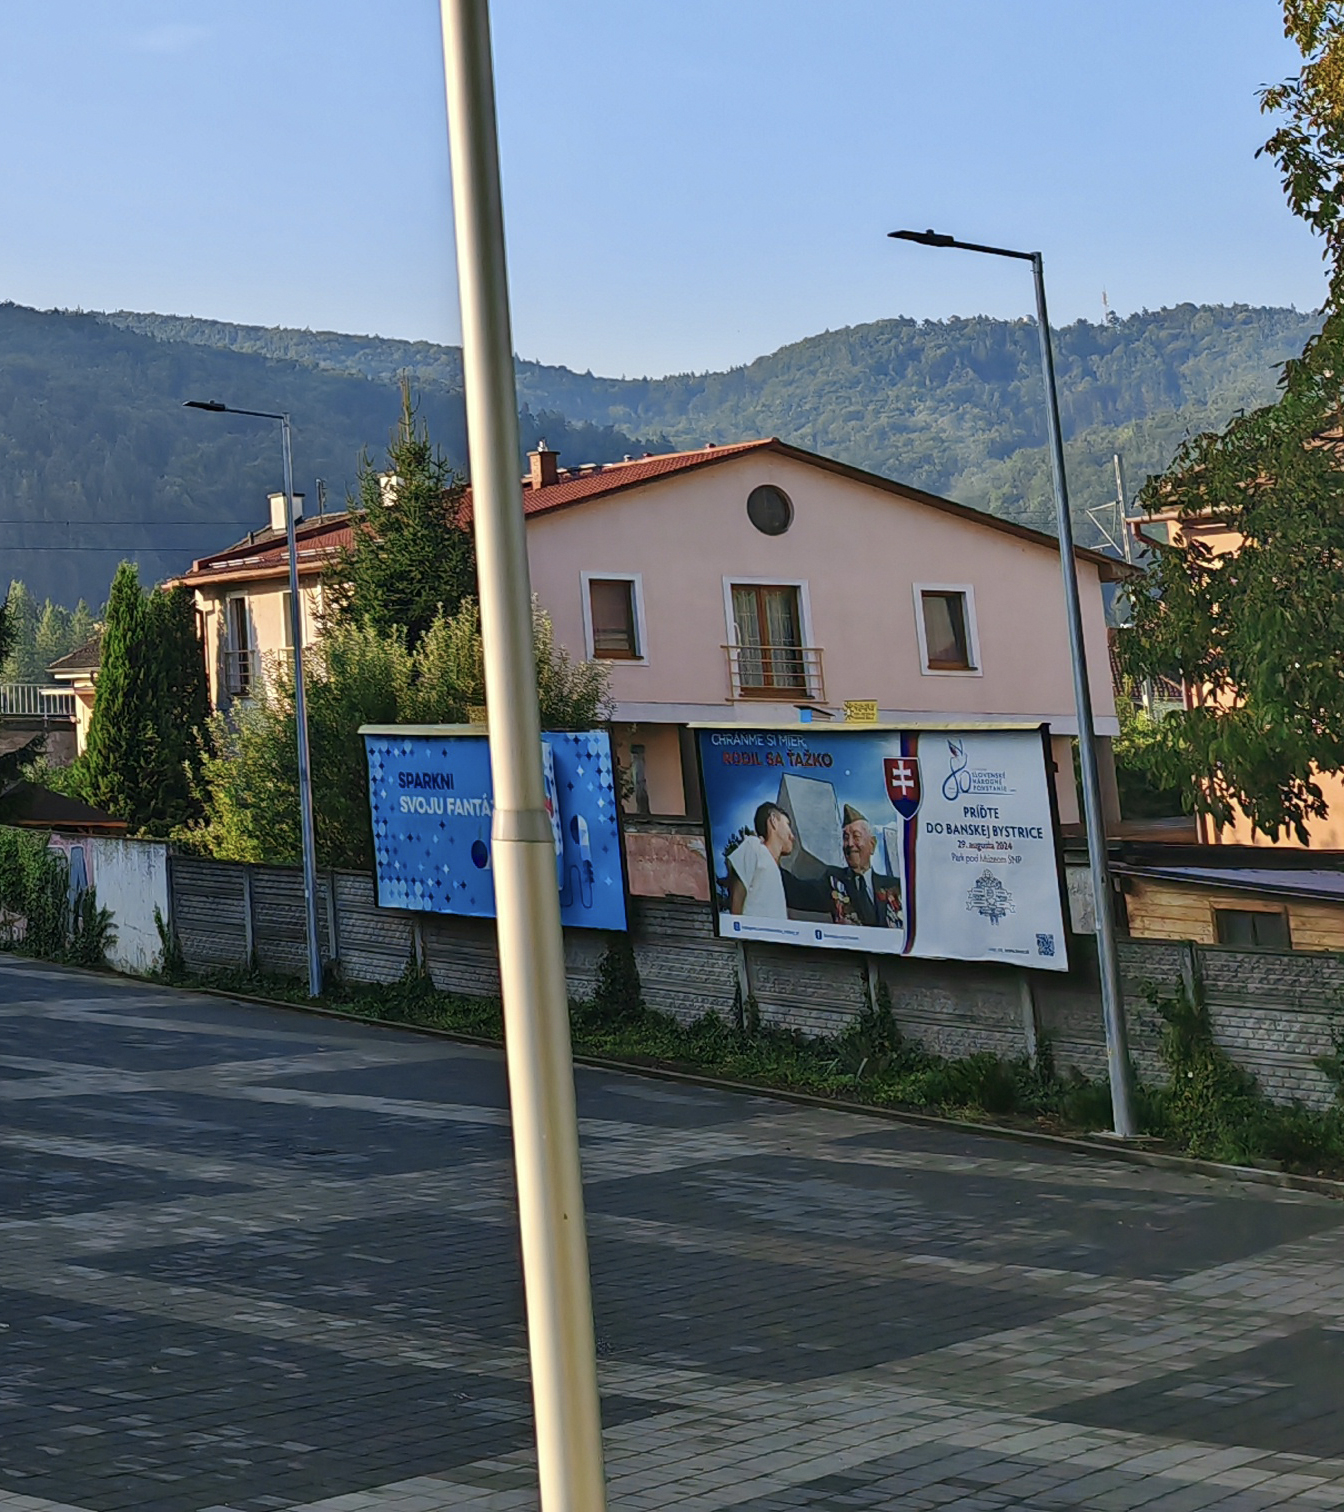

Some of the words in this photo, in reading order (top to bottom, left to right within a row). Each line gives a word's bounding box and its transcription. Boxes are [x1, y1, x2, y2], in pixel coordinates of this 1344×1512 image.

[766, 734, 777, 746] SI
[766, 751, 784, 766] SA
[787, 748, 833, 768] ŤAŽKO
[398, 772, 455, 791] SPARKNI
[400, 796, 444, 815] SVOJU
[446, 793, 494, 817] FANTÁ
[963, 804, 1000, 819] PRÍĎTE
[926, 822, 943, 834] DO
[946, 823, 990, 839] BANSKEJ
[993, 825, 1044, 840] BYSTRICE
[995, 840, 1013, 851] 2024
[965, 853, 979, 864] pod
